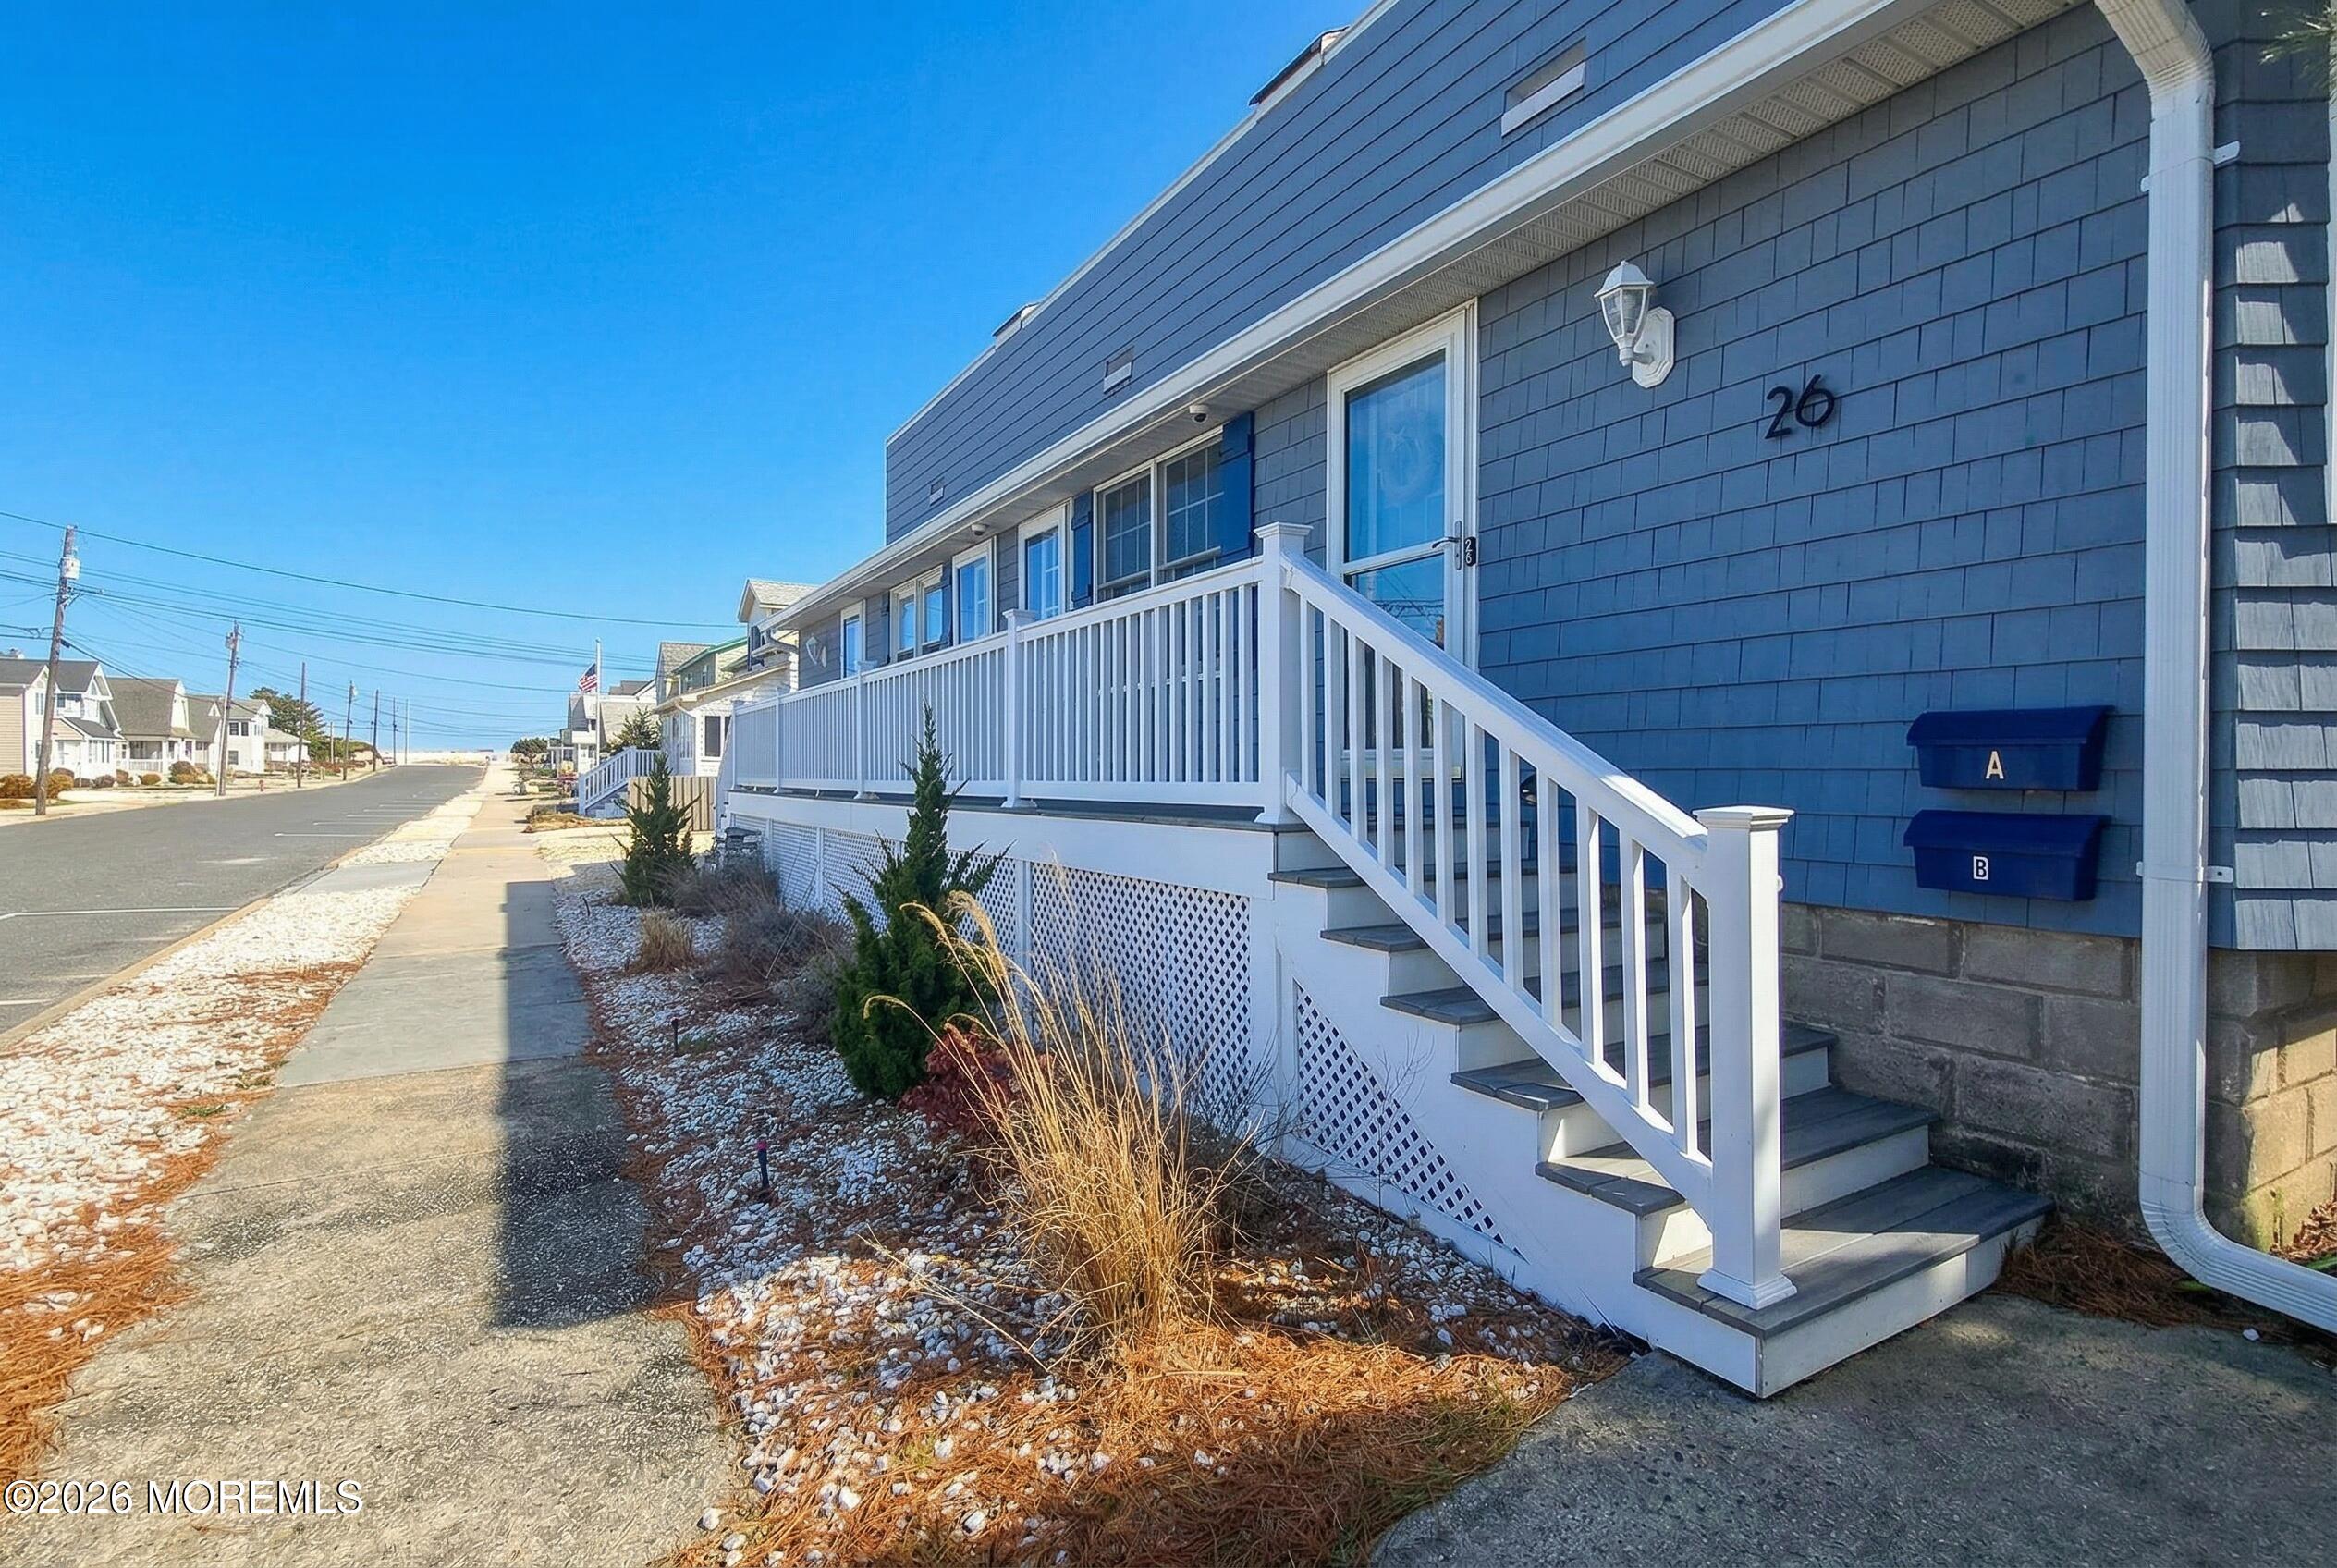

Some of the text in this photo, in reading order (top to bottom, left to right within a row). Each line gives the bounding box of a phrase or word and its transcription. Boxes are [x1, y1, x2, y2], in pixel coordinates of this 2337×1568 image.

[1764, 374, 1836, 439] 26
[1985, 750, 2005, 779] A
[1975, 857, 1988, 879] B
